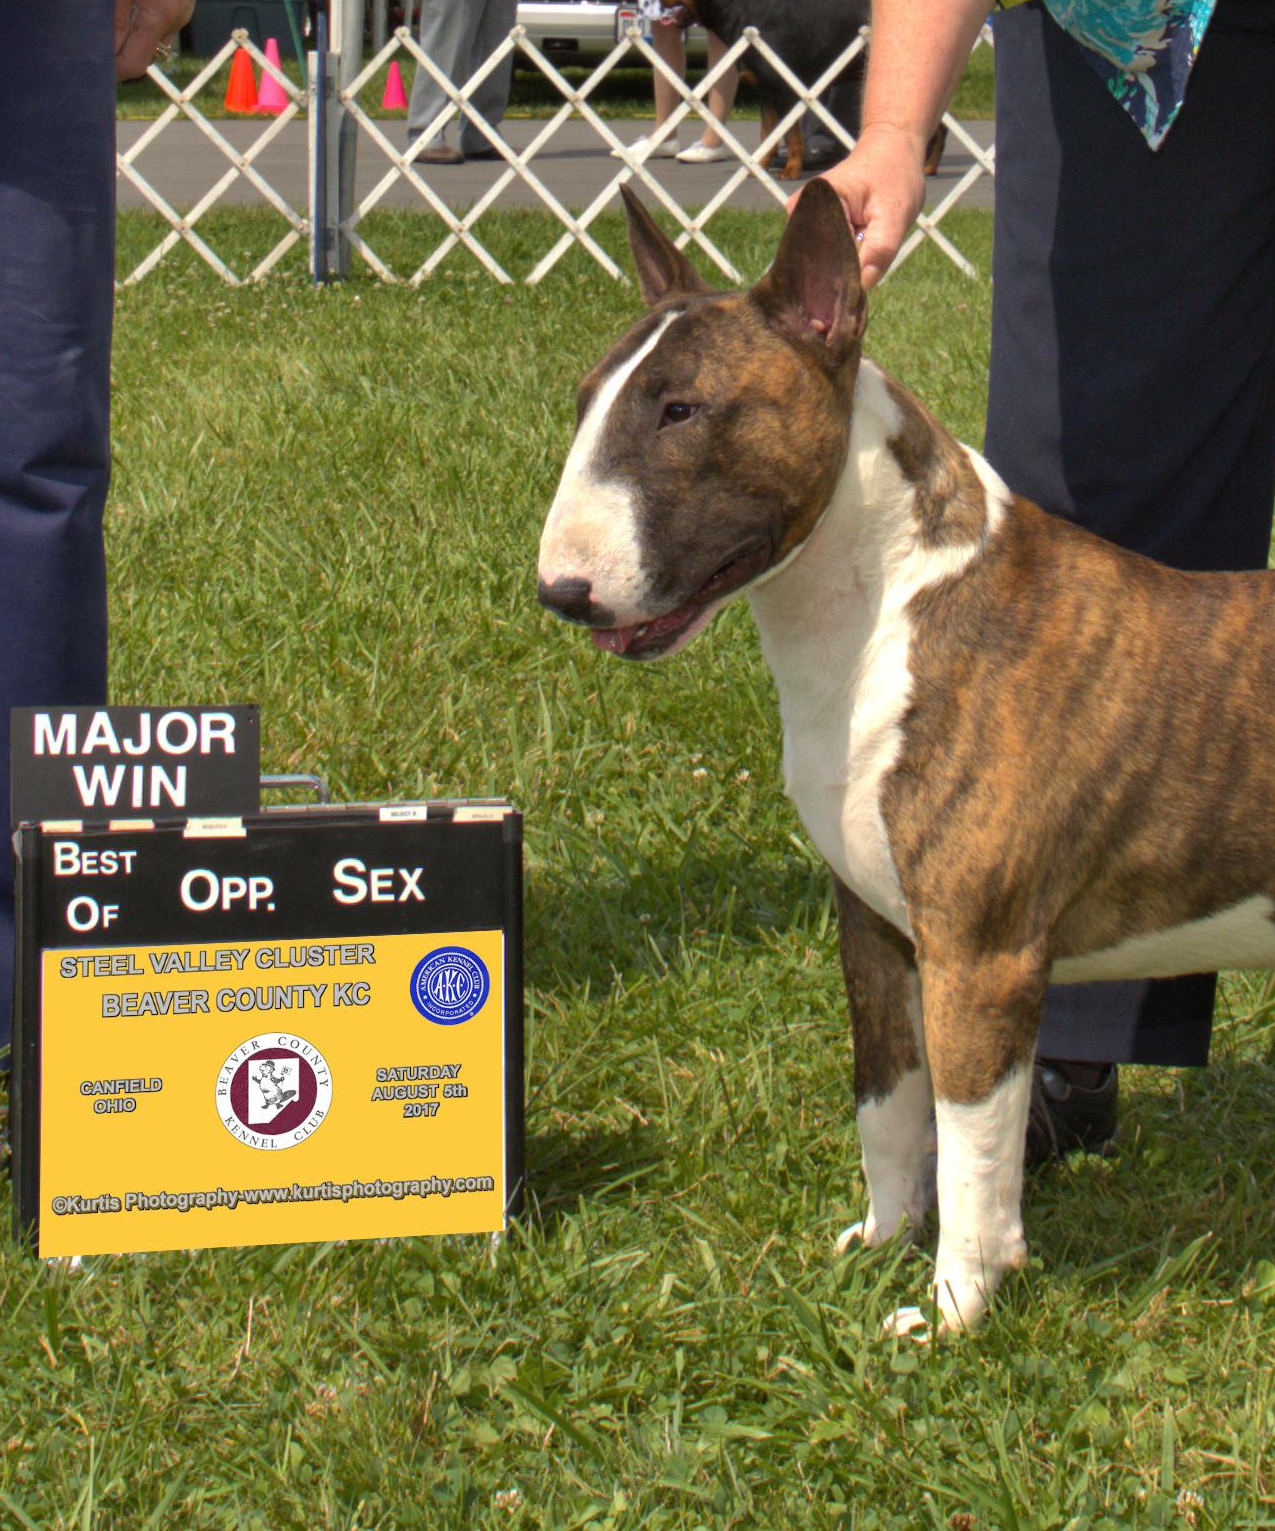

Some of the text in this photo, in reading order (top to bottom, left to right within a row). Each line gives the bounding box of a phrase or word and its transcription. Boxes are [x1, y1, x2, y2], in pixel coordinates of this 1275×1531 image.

[34, 711, 236, 755] MAJOR
[73, 765, 188, 808] WIN
[60, 943, 376, 978] STEEL VALLEY CLUSTER
[420, 957, 446, 992] AMERICAN
[447, 956, 475, 972] KENNEL
[102, 982, 371, 1018] BEAVER COUNTY KC
[426, 1000, 474, 1016] INCORPORATED
[217, 1035, 329, 1096] BEAVER COUNTY
[376, 1064, 461, 1082] SATURDAY
[80, 1077, 162, 1095] CANFIELD
[371, 1083, 468, 1101] AUGUST 5th
[93, 1097, 136, 1114] OHIO
[403, 1101, 440, 1118] 2017
[224, 1110, 325, 1149] KENNEL CLUB
